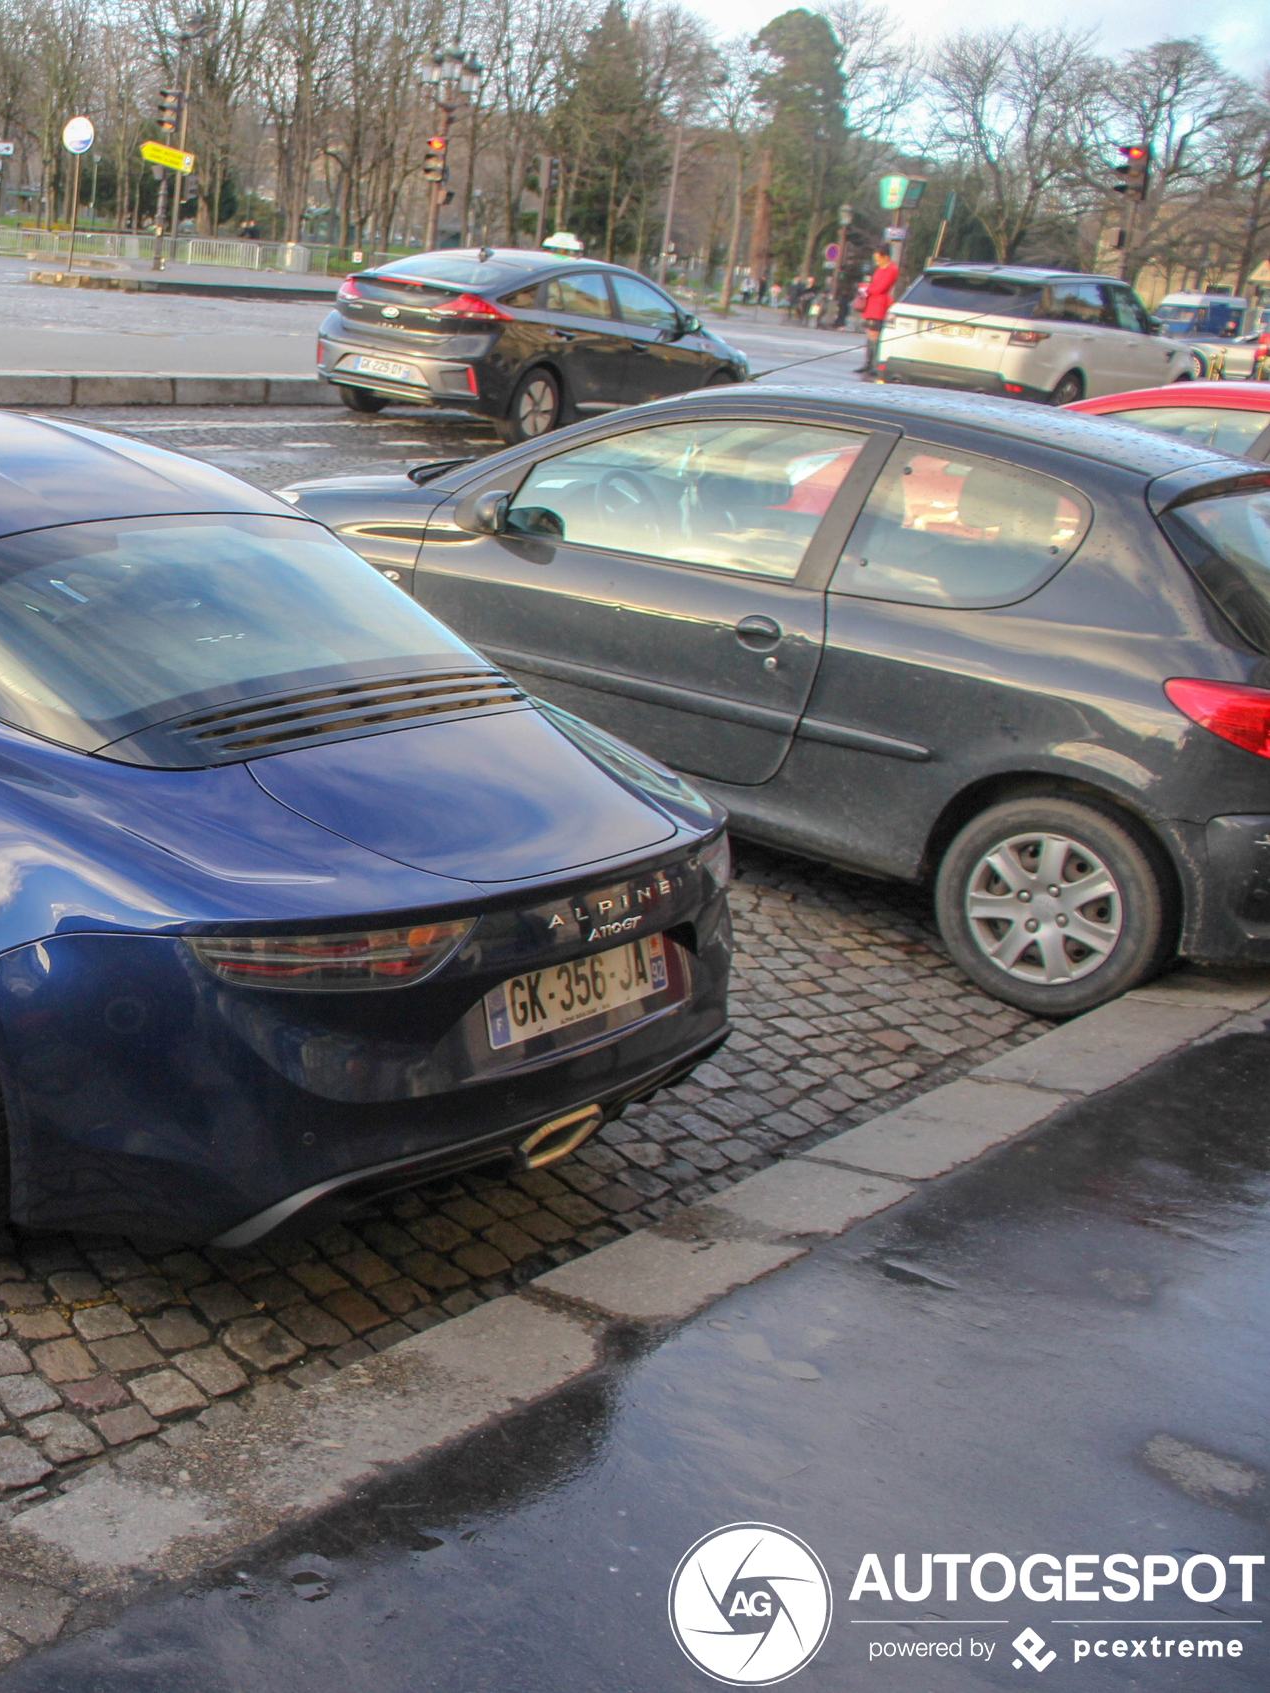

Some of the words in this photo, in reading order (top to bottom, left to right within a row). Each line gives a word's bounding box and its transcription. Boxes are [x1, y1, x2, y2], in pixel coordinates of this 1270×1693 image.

[548, 880, 671, 929] ALPINE
[495, 1017, 503, 1033] F
[509, 940, 649, 1028] GK-356-JA
[651, 960, 666, 983] 92
